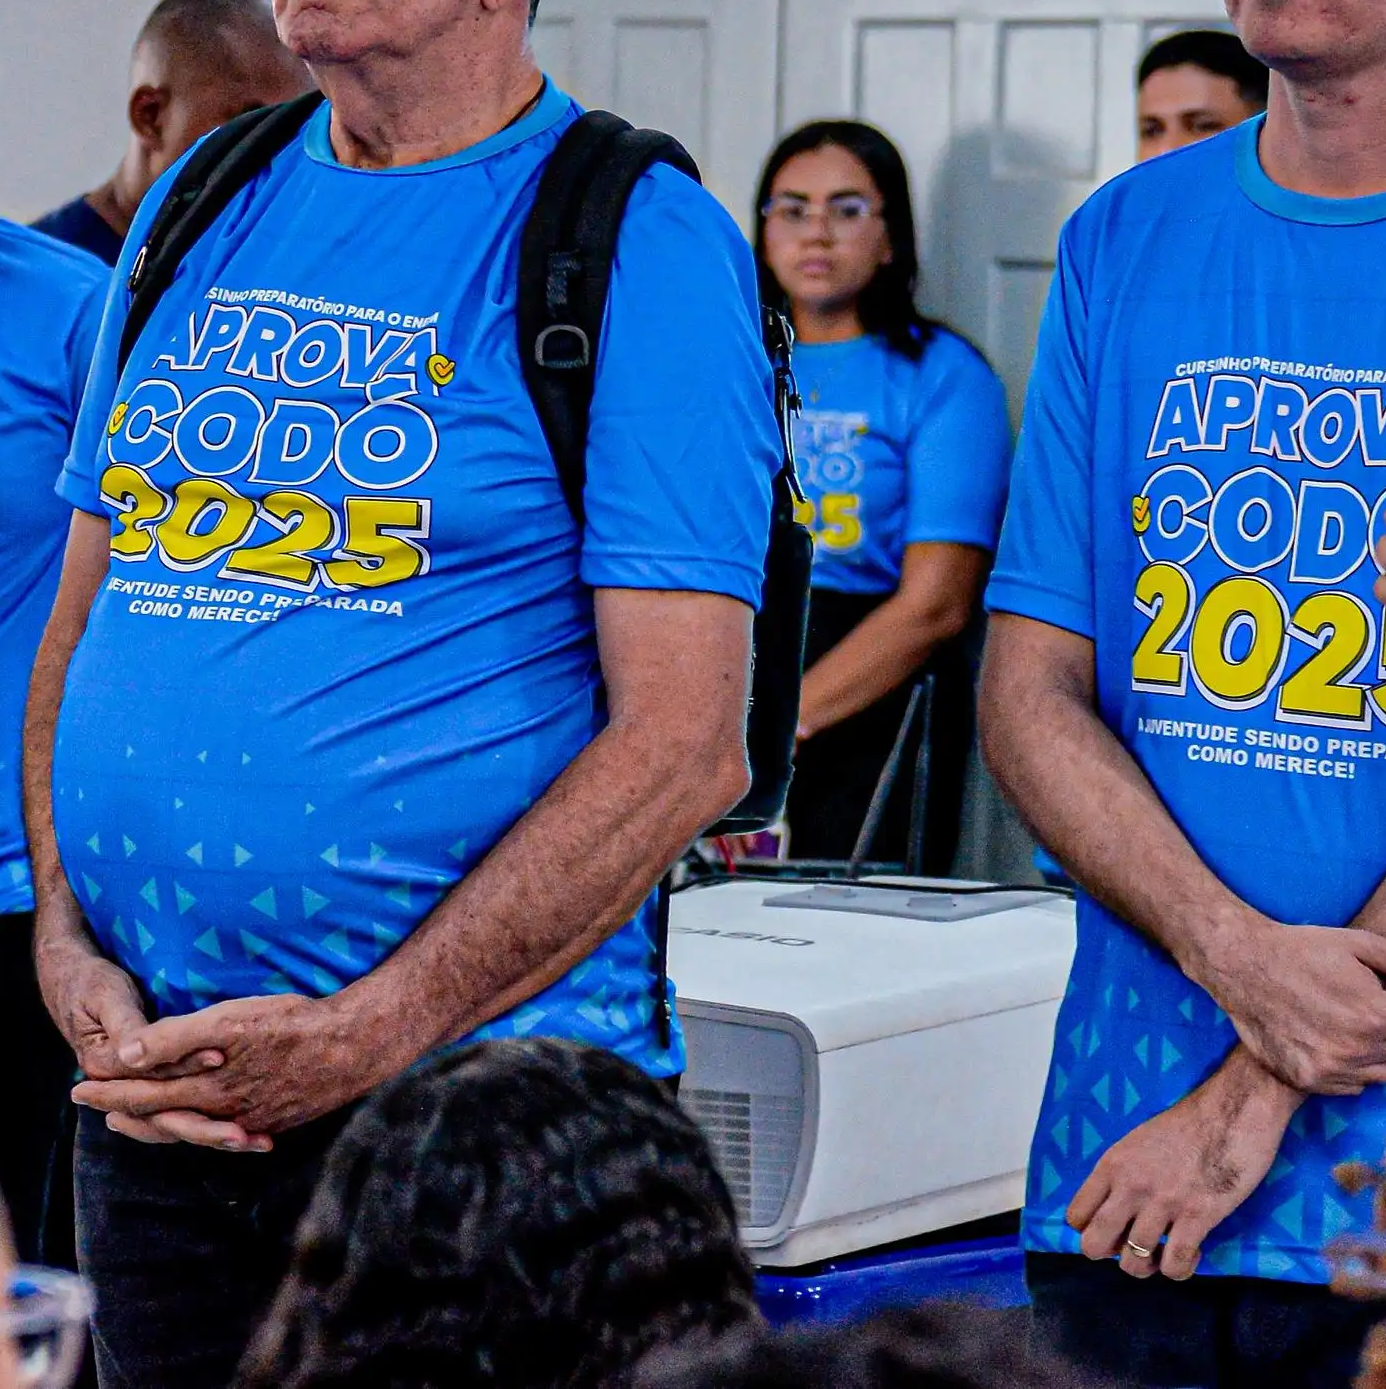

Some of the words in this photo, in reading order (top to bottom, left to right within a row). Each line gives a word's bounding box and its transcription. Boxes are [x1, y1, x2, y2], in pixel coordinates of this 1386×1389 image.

[248, 289, 346, 317] PREPARATÓRIO
[345, 304, 386, 323] PARA
[387, 312, 401, 326] O
[151, 303, 439, 398] APROVA
[1175, 356, 1252, 377] CURSINHO
[1251, 356, 1355, 384] PREPARATÓRIO
[107, 373, 439, 490] CODÓ
[99, 462, 433, 595] 2025
[128, 599, 183, 619] COMO
[182, 585, 253, 604] SENDO
[1244, 728, 1320, 753] SENDO
[1187, 744, 1248, 766] COMO
[1255, 753, 1356, 779] MERECE!
